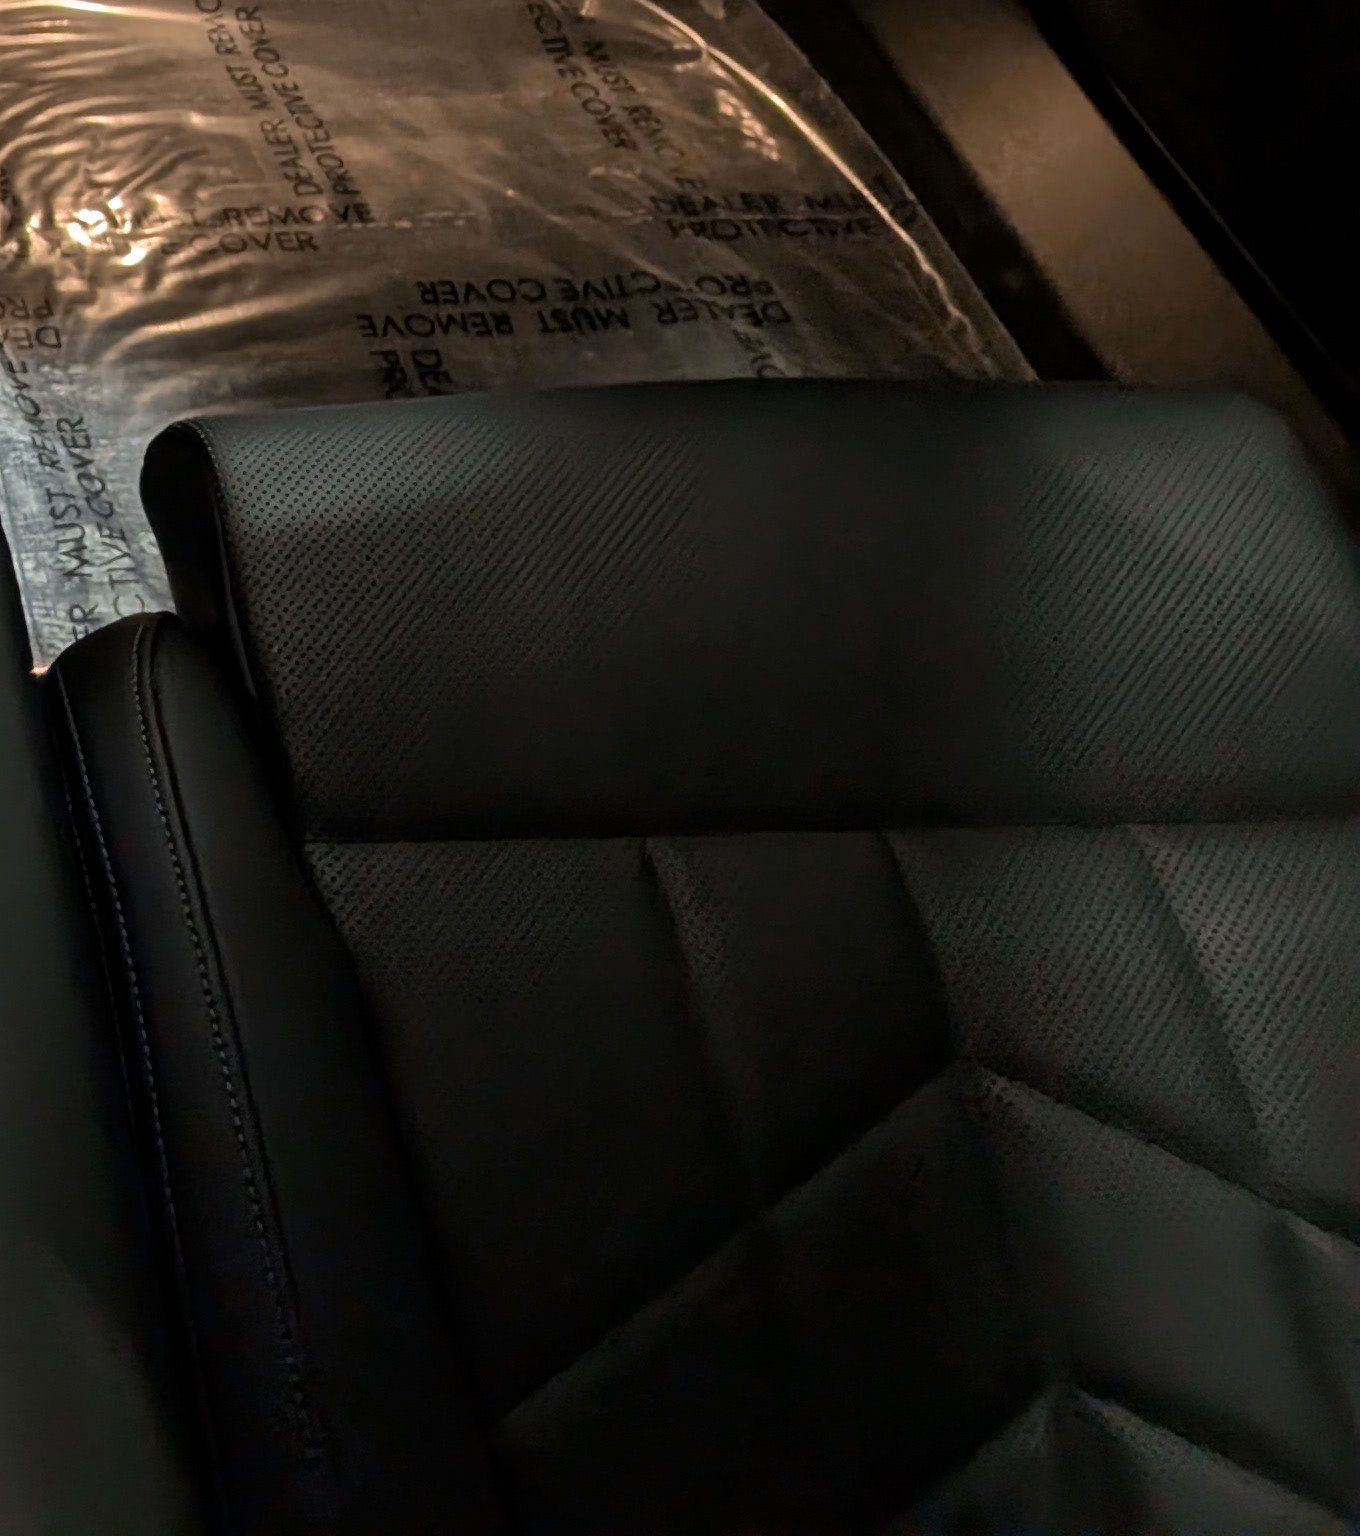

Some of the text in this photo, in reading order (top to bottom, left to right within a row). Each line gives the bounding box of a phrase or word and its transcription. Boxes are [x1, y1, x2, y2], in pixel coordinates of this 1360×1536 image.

[416, 277, 548, 306] COVER
[356, 311, 515, 339] REMOVE
[55, 415, 115, 520] COVER
[46, 487, 93, 578] MUST
